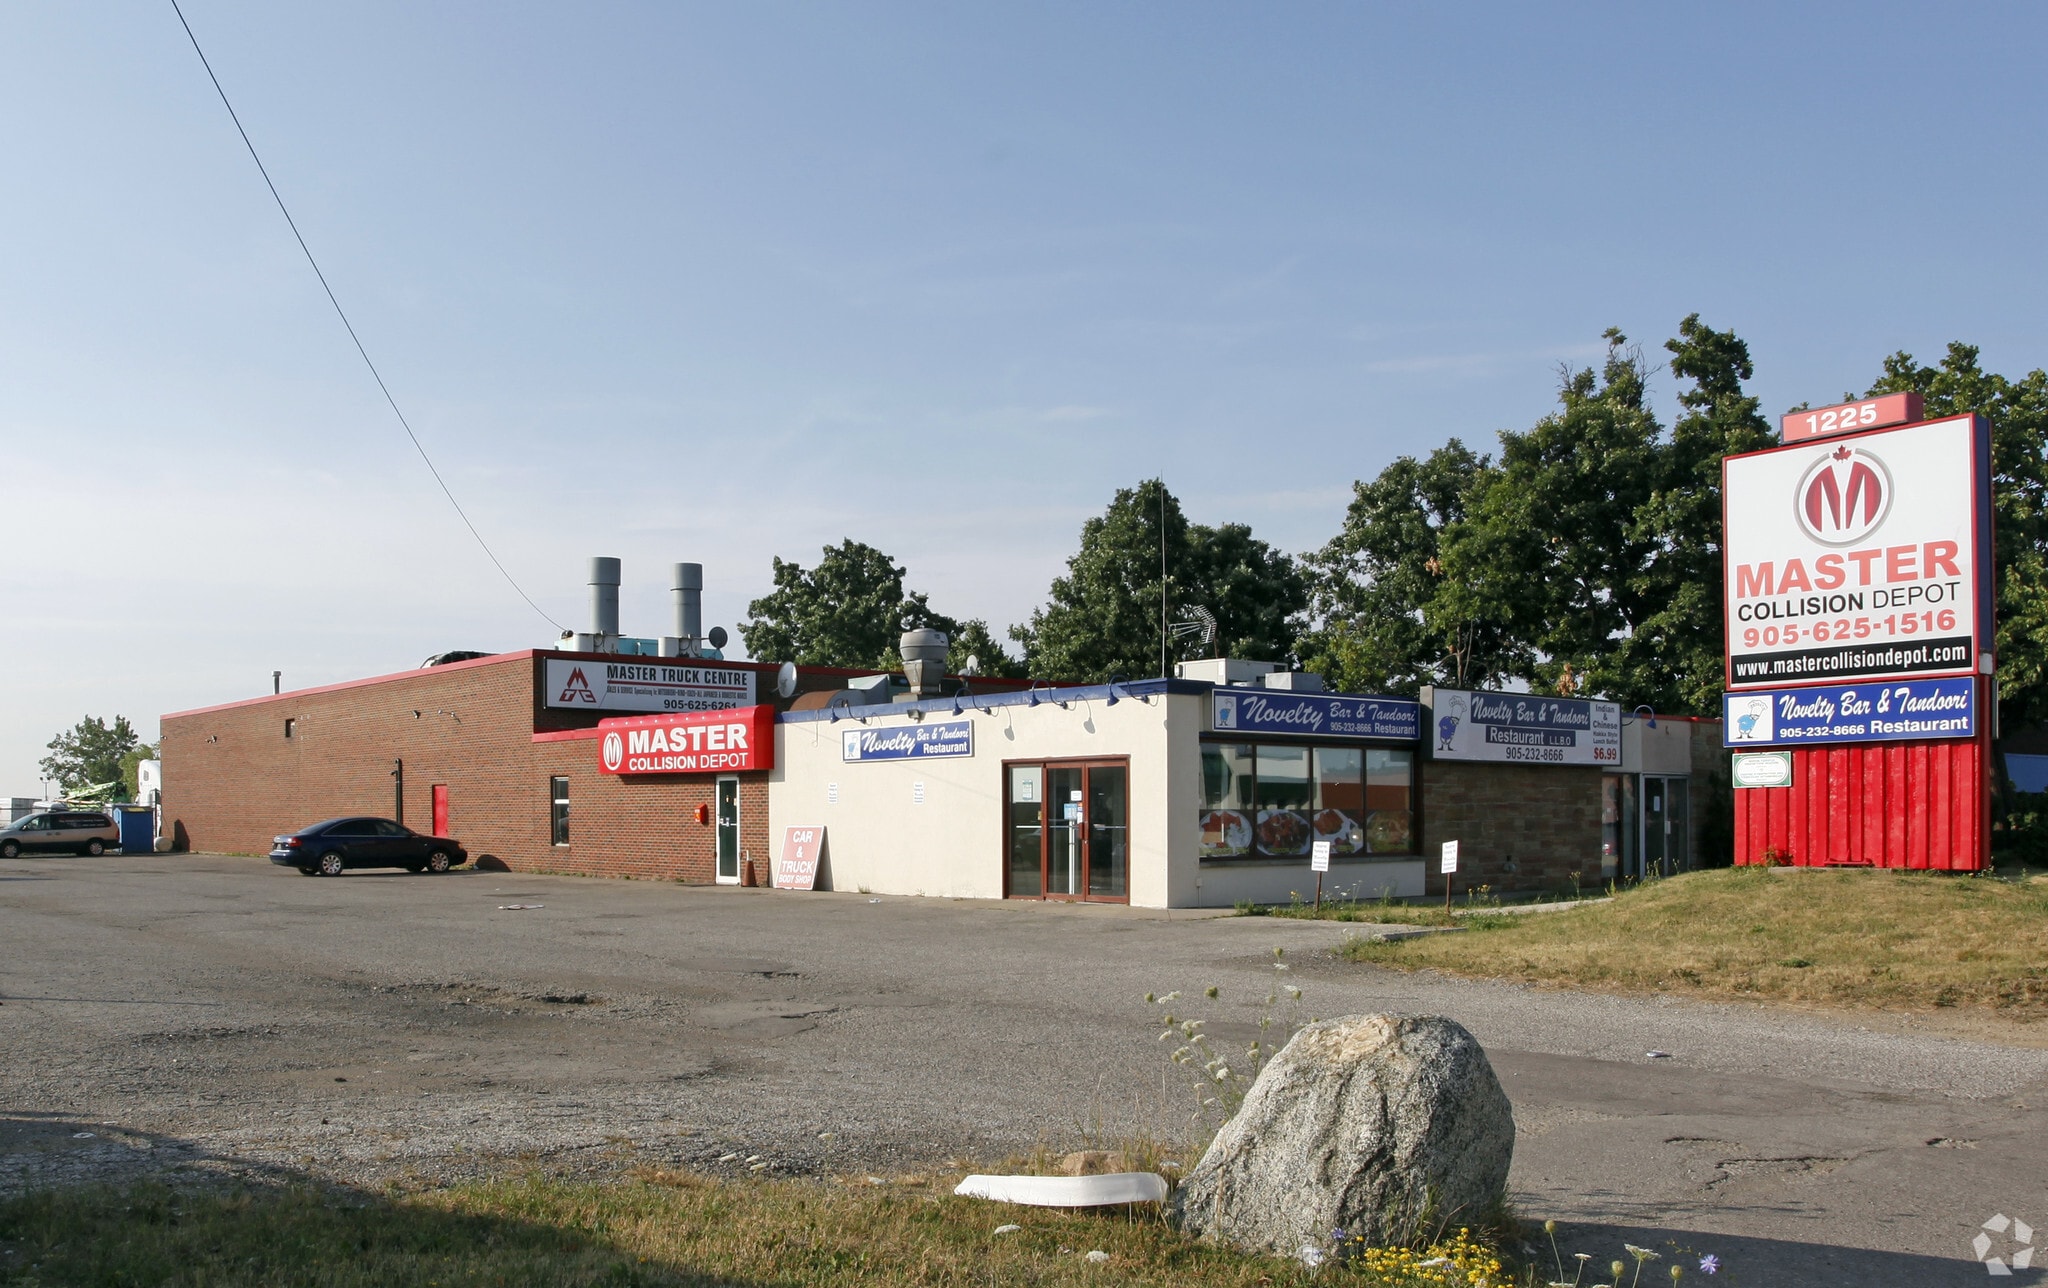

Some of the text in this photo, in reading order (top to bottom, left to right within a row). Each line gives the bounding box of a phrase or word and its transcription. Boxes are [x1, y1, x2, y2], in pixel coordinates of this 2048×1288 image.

[1806, 403, 1877, 434] 1225
[1736, 540, 1962, 599] MASTER
[1737, 582, 1961, 622] COLLISION DEPOT
[1743, 608, 1956, 648] 905-625-1516
[1736, 645, 1966, 677] www.mastercollisiondepot.com
[607, 665, 748, 686] MASTER TRUCK CENTRE
[1243, 695, 1416, 731] Novelty Bar & Tandoori
[1472, 696, 1512, 725] Novelty
[1517, 702, 1535, 722] Bar
[1538, 703, 1547, 722] &
[1550, 703, 1590, 725] Tandoori
[1595, 704, 1615, 713] Indian
[1779, 694, 1835, 723] Novelty
[1840, 691, 1871, 716] Bar
[1877, 688, 1890, 713] &
[1894, 687, 1968, 714] Tandoori
[1330, 723, 1416, 735] 905-232-8666 Restaurant
[1593, 720, 1618, 729] Chinese
[1780, 716, 1969, 738] 905-232-8666 Restaurant
[628, 723, 748, 755] MASTER
[861, 726, 969, 755] Novelty Bar & Tandoori
[1490, 729, 1544, 745] Restaurant
[923, 742, 968, 754] Restaurant
[1506, 747, 1563, 761] 905-232-8666
[1594, 747, 1616, 760] $6.99
[629, 752, 748, 771] COLLISION DEPOT
[793, 830, 813, 843] CAR
[796, 846, 803, 858] &
[781, 861, 814, 874] TRUCK
[778, 874, 811, 884] BODY SHOP
